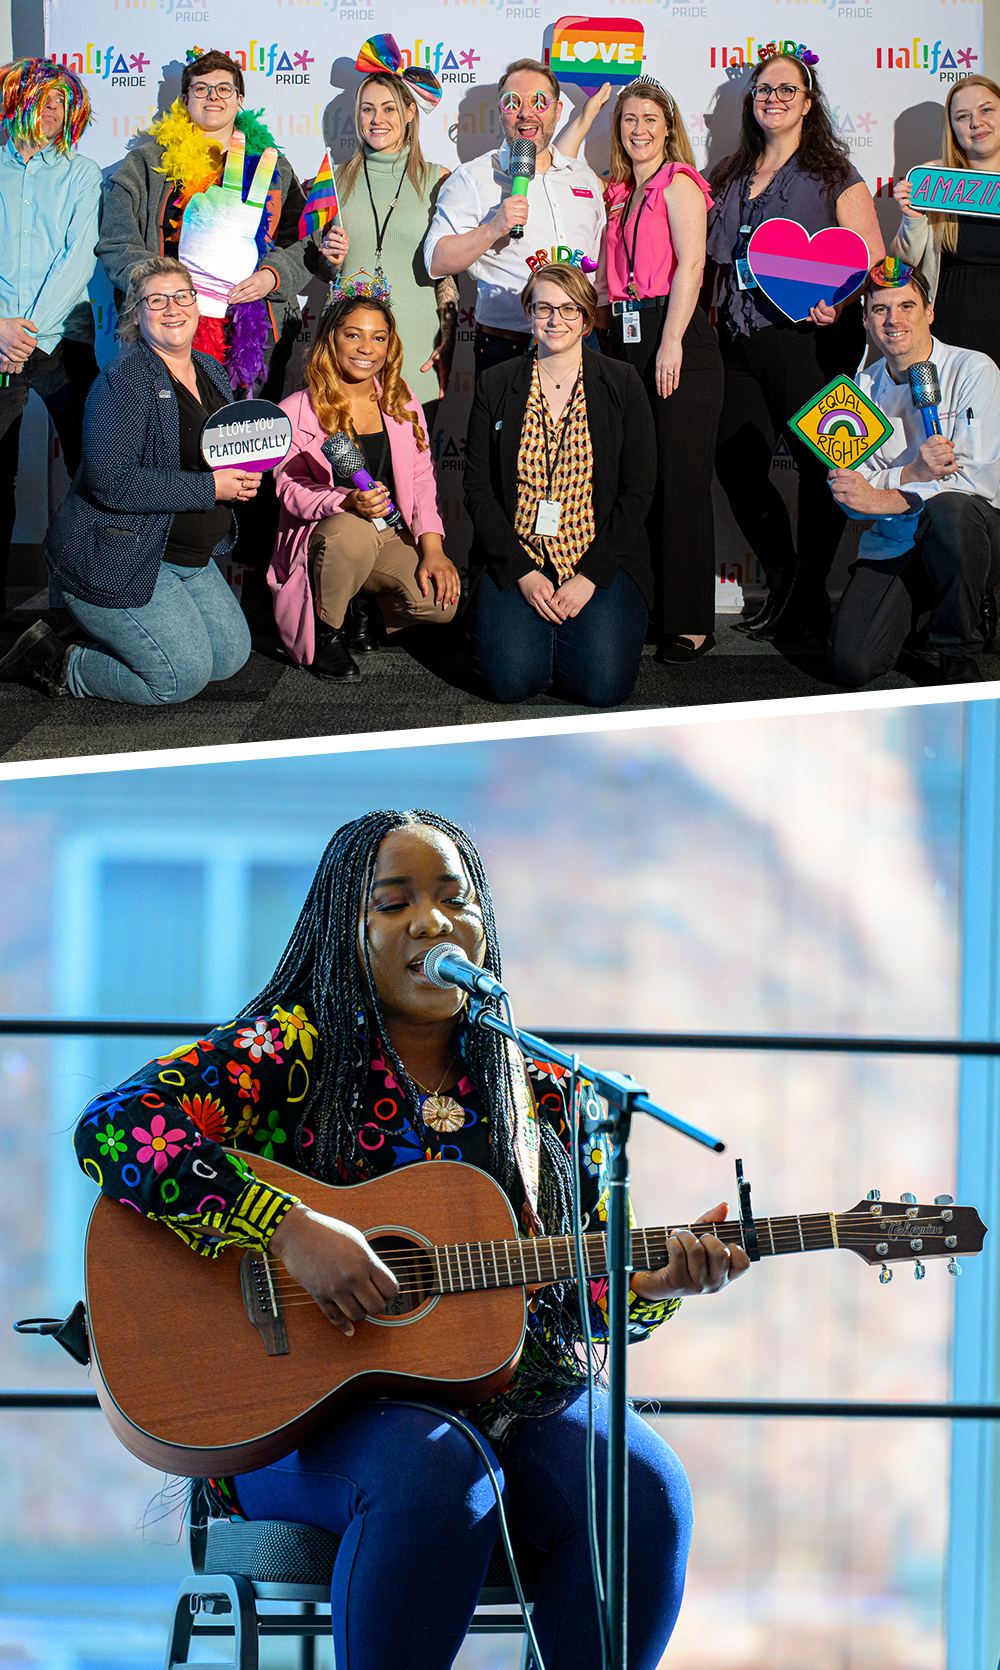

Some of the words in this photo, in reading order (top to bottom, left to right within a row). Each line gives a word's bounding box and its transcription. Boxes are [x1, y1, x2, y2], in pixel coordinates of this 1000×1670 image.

[175, 11, 210, 22] PRIDE
[339, 9, 375, 21] PRIDE
[506, 7, 541, 19] PRIDE
[672, 6, 707, 18] PRIDE
[837, 7, 873, 18] PRIDE
[560, 40, 636, 65] LOVE
[757, 40, 809, 62] PRIDE
[111, 76, 146, 87] PRIDE
[275, 74, 311, 85] PRIDE
[441, 72, 476, 84] PRIDE
[525, 245, 585, 274] PRIDE
[818, 385, 862, 415] EQUAL
[217, 424, 225, 438] I
[226, 420, 252, 437] LOVE
[253, 416, 275, 432] YOU
[209, 433, 287, 459] PLATONICALLY
[817, 435, 869, 465] RIGHTS
